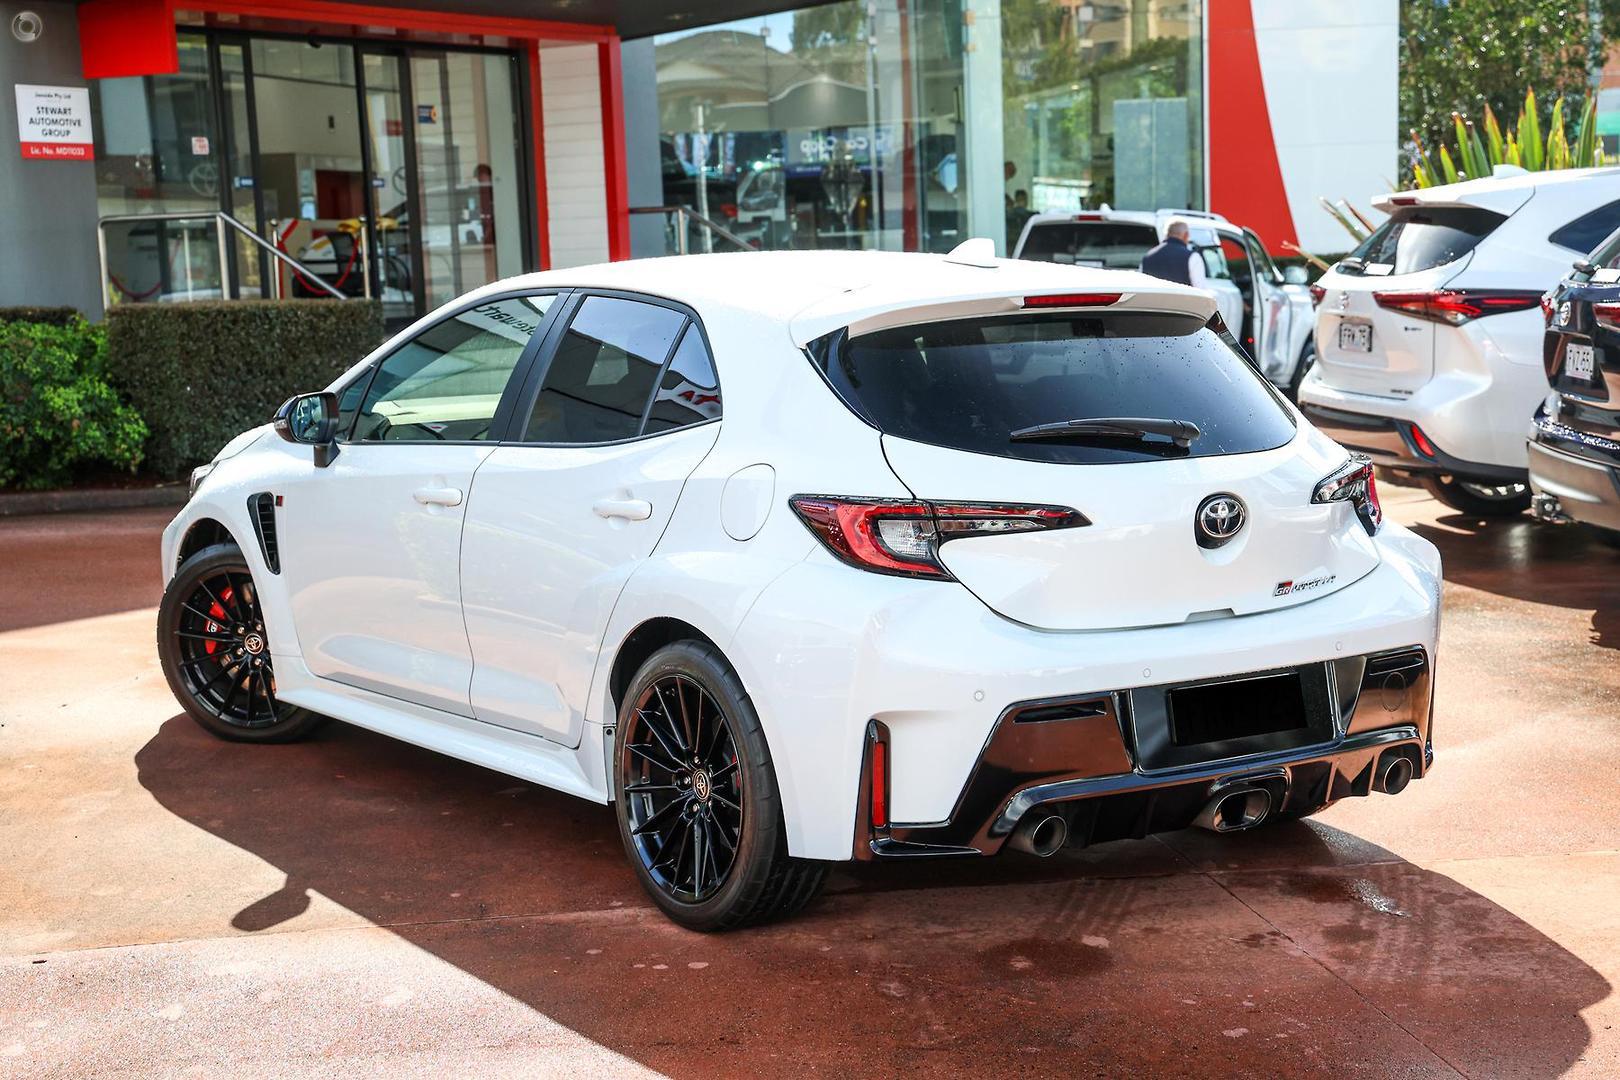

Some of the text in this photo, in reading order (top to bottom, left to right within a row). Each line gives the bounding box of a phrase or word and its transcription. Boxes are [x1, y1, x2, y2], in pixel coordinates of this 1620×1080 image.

[36, 106, 72, 116] STEWART
[28, 117, 82, 127] AUTOMOTIVE
[41, 128, 71, 138] GROUP
[30, 146, 41, 155] Lic.
[42, 146, 54, 156] No.
